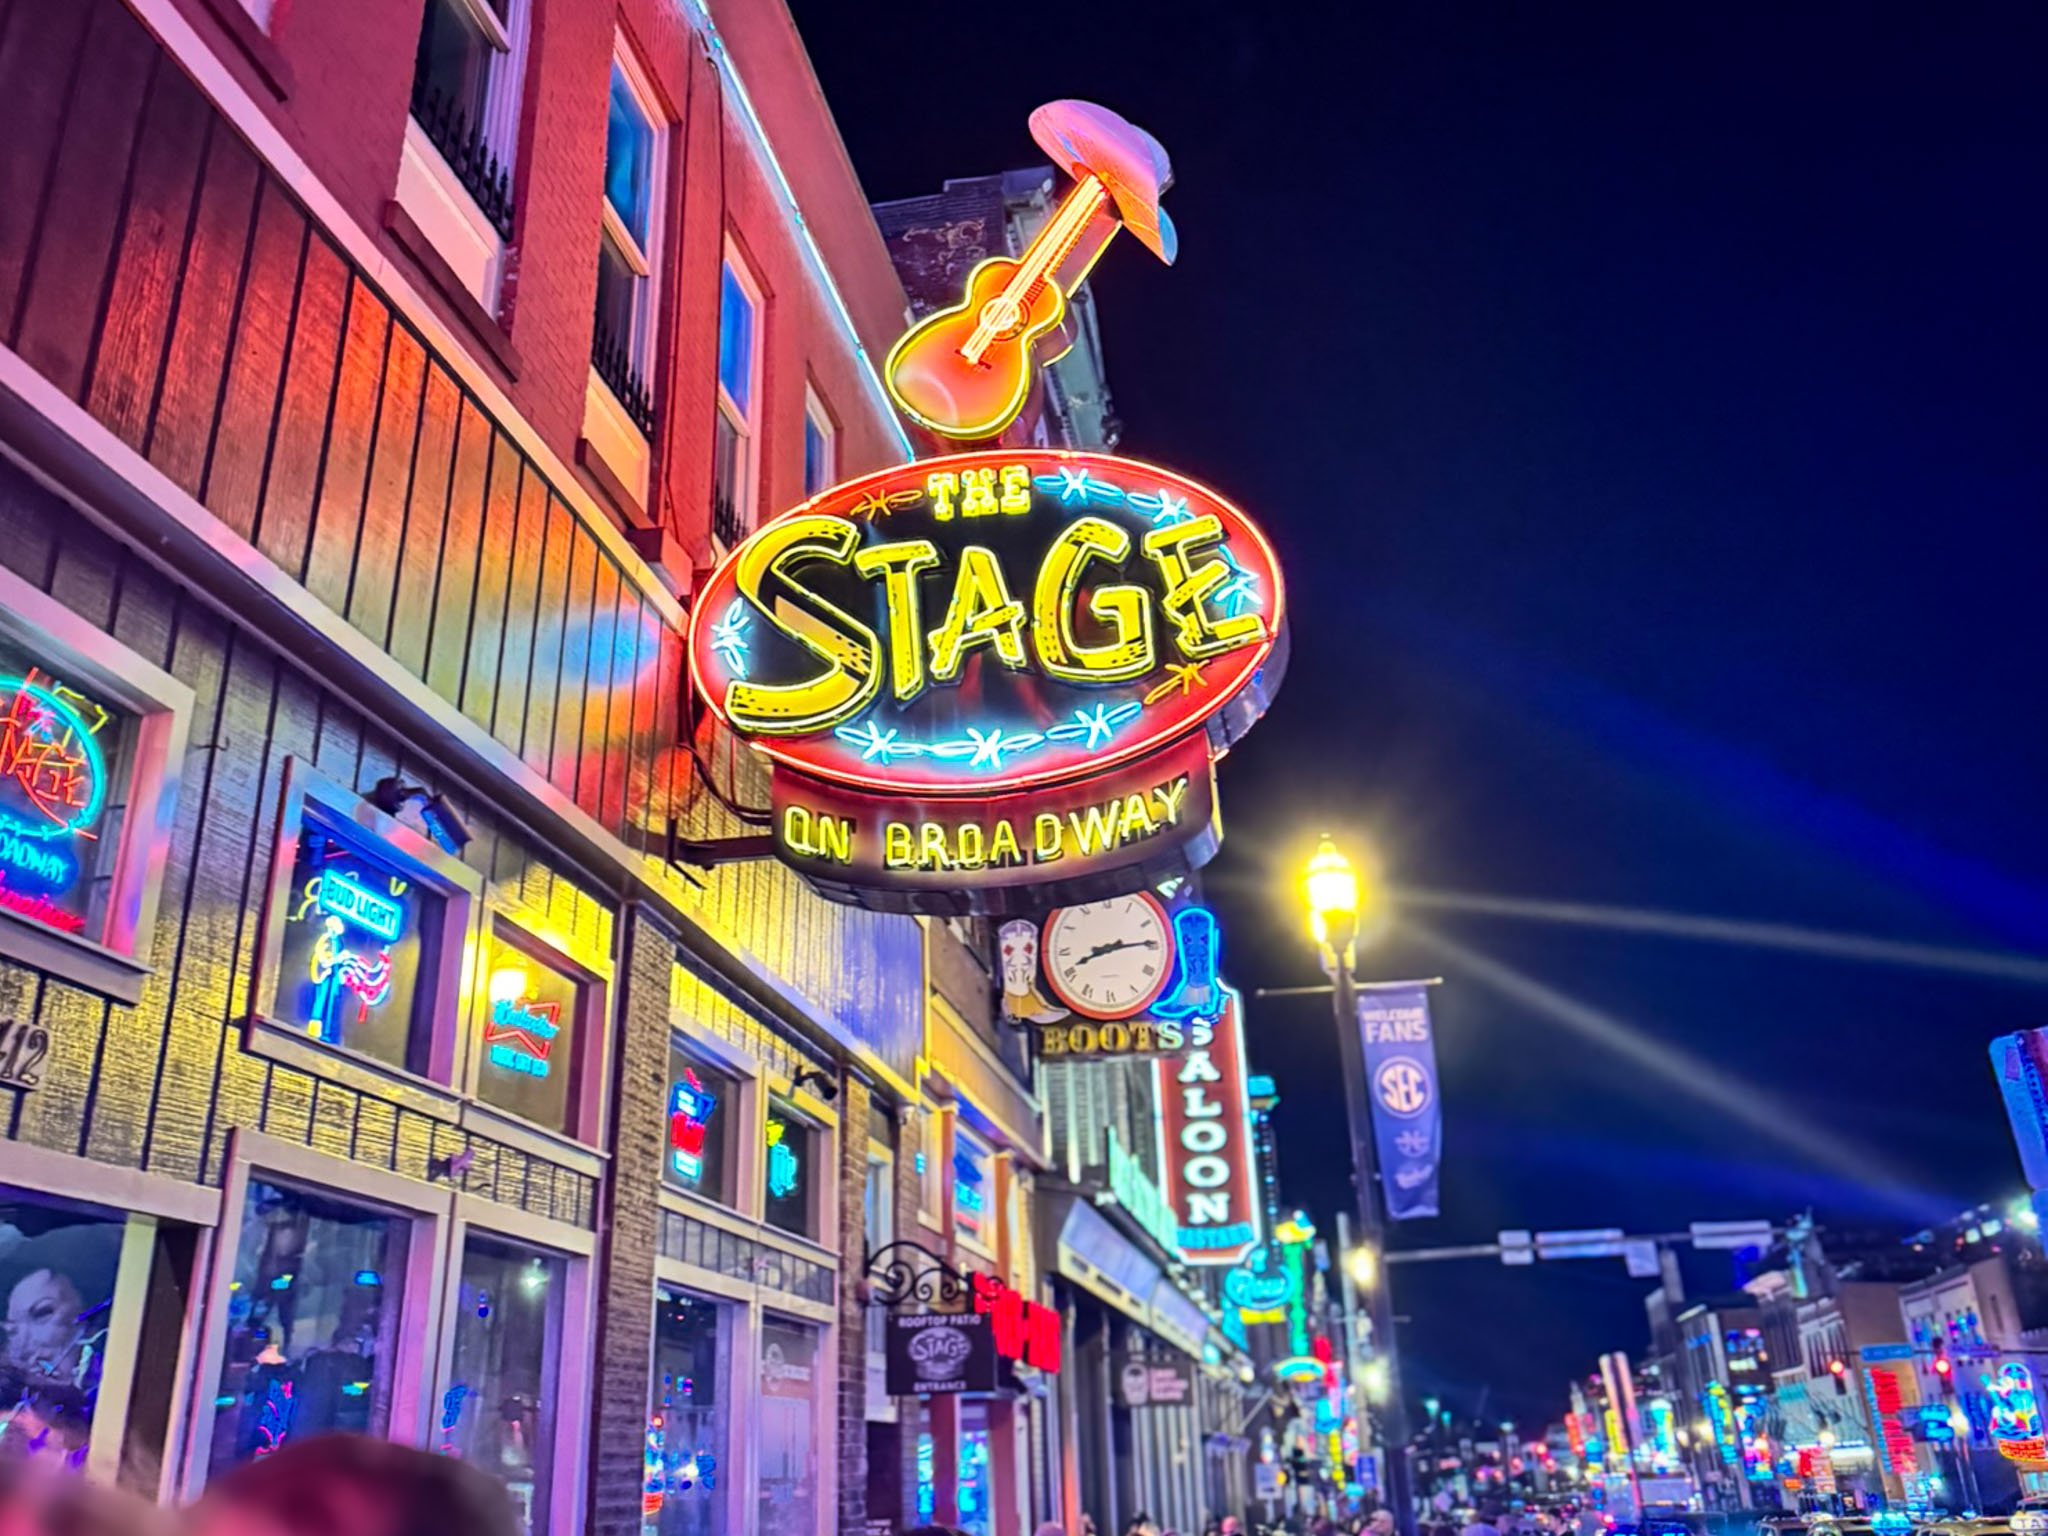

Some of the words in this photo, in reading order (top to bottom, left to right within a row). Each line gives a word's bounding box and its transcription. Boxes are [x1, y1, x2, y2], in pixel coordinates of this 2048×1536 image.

[927, 465, 1031, 521] THE
[724, 514, 1266, 733] STAGE
[783, 806, 854, 864] ON
[885, 777, 1189, 872] BROADWAY
[325, 878, 357, 910] BUD
[357, 894, 396, 931] LIGHT
[1042, 1019, 1185, 1056] BOOTS
[1362, 1007, 1425, 1021] WELCOME
[1365, 1022, 1428, 1044] FANS
[0, 1020, 49, 1086] 12
[1381, 1064, 1426, 1112] SEC
[1177, 1016, 1230, 1224] SALOON
[898, 1314, 947, 1328] ROOFTOP
[949, 1312, 982, 1326] PATIO
[911, 1334, 970, 1360] STAGE
[913, 1381, 967, 1392] ENTRANCE
